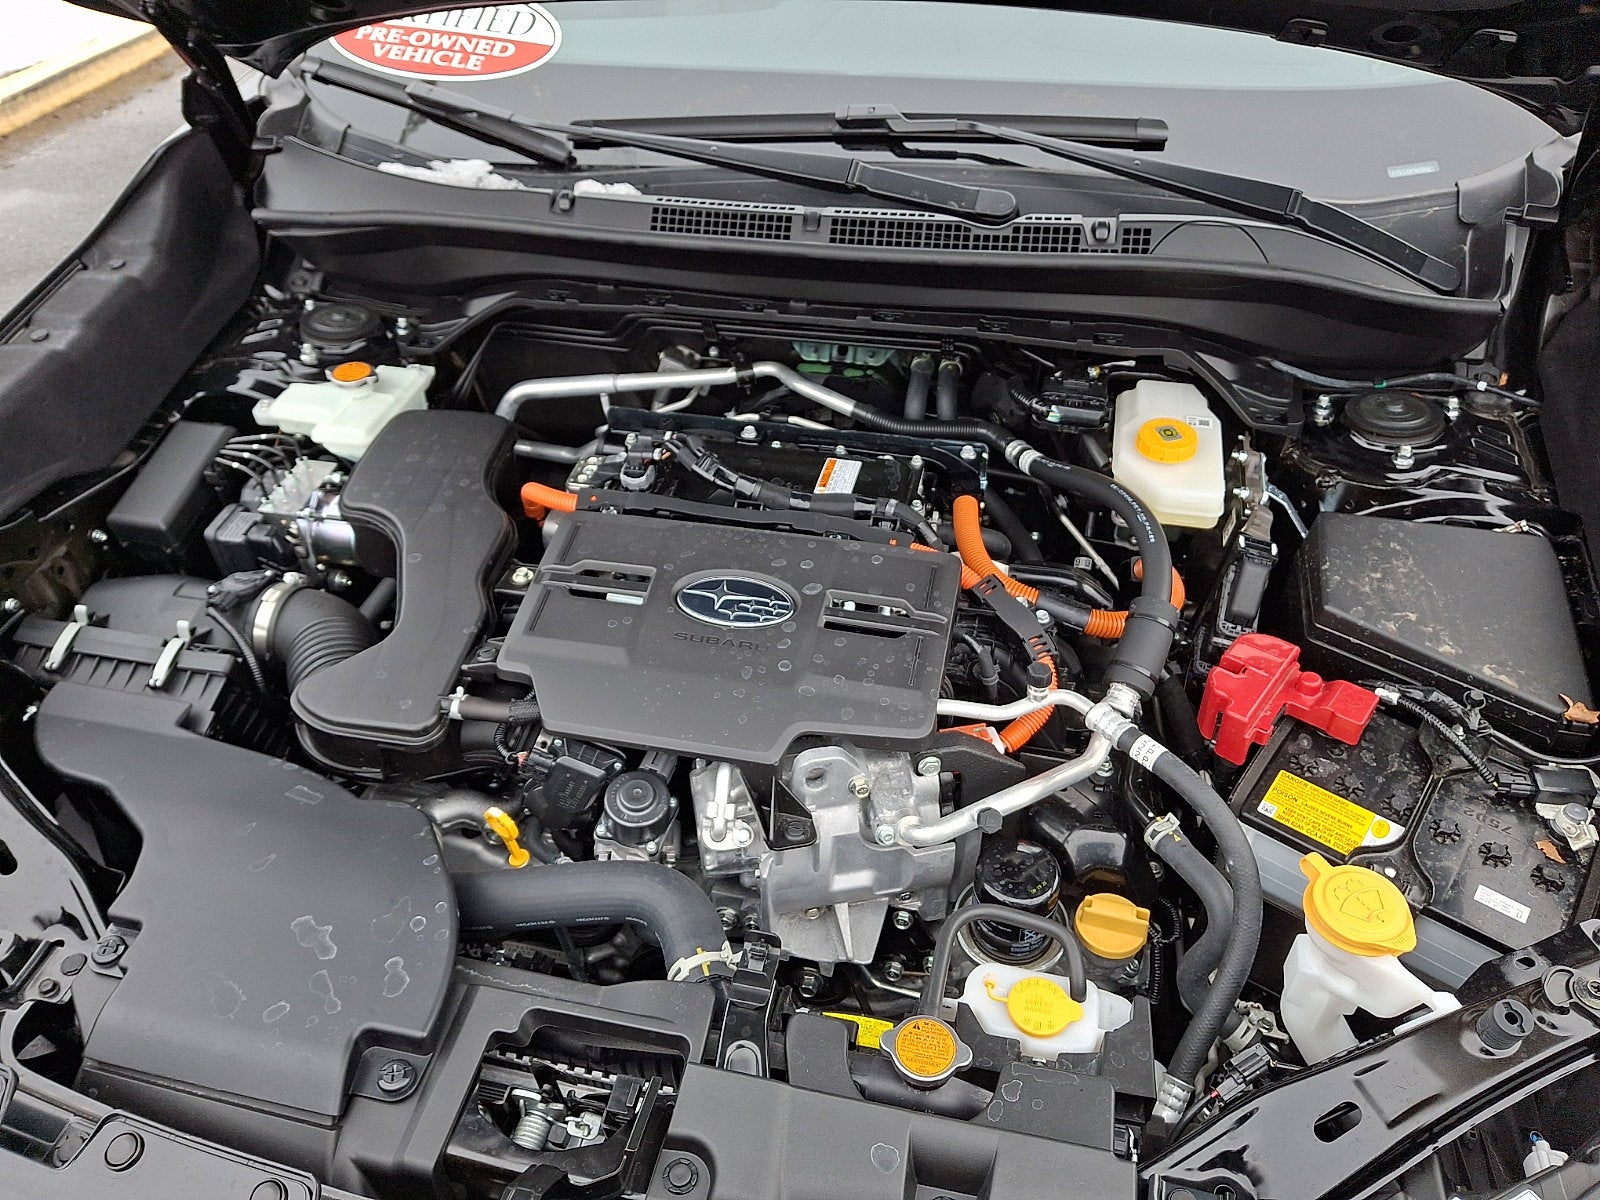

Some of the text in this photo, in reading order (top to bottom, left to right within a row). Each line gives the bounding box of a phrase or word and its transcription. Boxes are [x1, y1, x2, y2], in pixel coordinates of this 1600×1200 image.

[354, 25, 516, 58] PRE-OWNED
[372, 42, 484, 72] VEHICLE
[673, 631, 770, 651] SUBARU
[1281, 771, 1308, 788] DANGER
[1271, 785, 1298, 803] POISON
